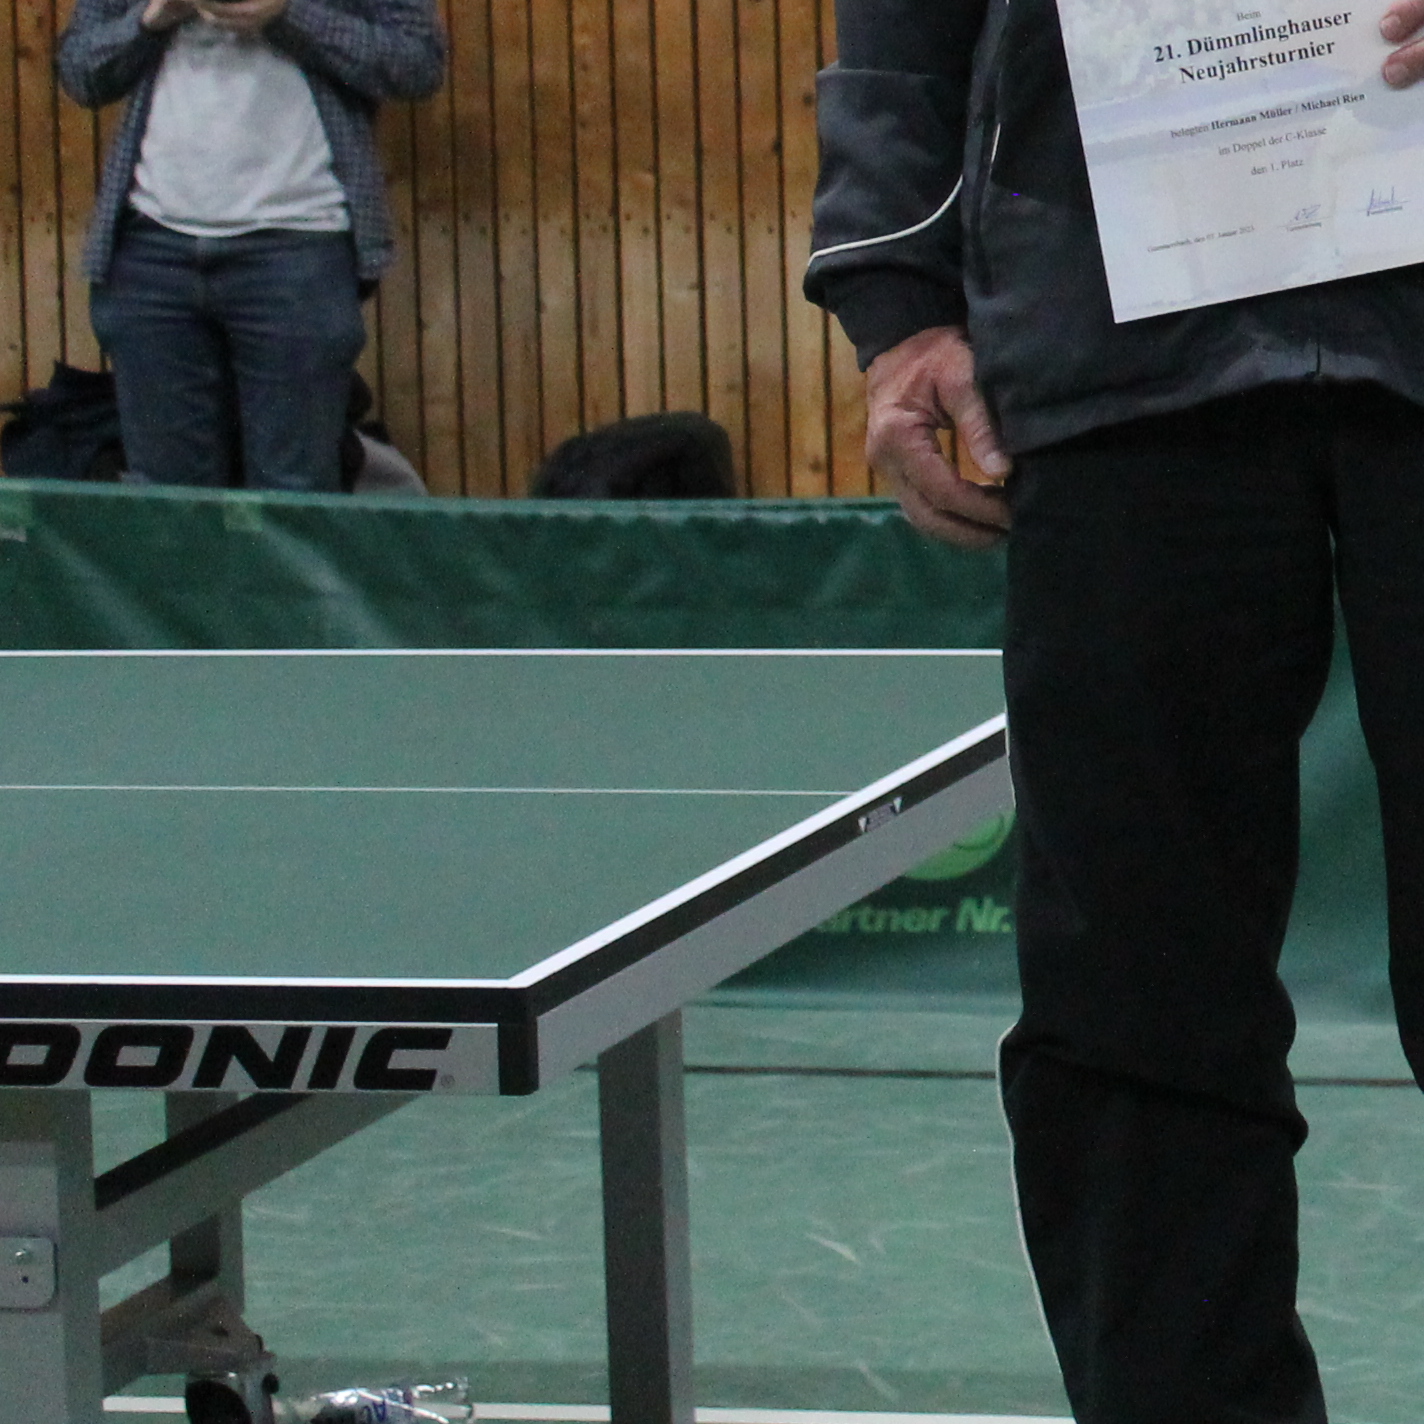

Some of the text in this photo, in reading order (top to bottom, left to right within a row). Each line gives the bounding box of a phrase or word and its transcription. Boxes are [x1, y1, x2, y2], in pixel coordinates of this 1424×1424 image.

[1236, 10, 1262, 22] Beim
[1153, 11, 1353, 63] 21. Dümmlinghauser
[1180, 40, 1336, 83] Neujahrsturnier
[1211, 115, 1257, 130] Hermann
[1259, 108, 1293, 121] Müller
[1301, 98, 1341, 112] Michael
[1218, 128, 1327, 156] im Doppel der C-Klasse
[1250, 166, 1267, 176] den
[1281, 159, 1304, 170] Platz
[956, 896, 1011, 932] Nr.
[0, 1023, 453, 1090] DONIC
